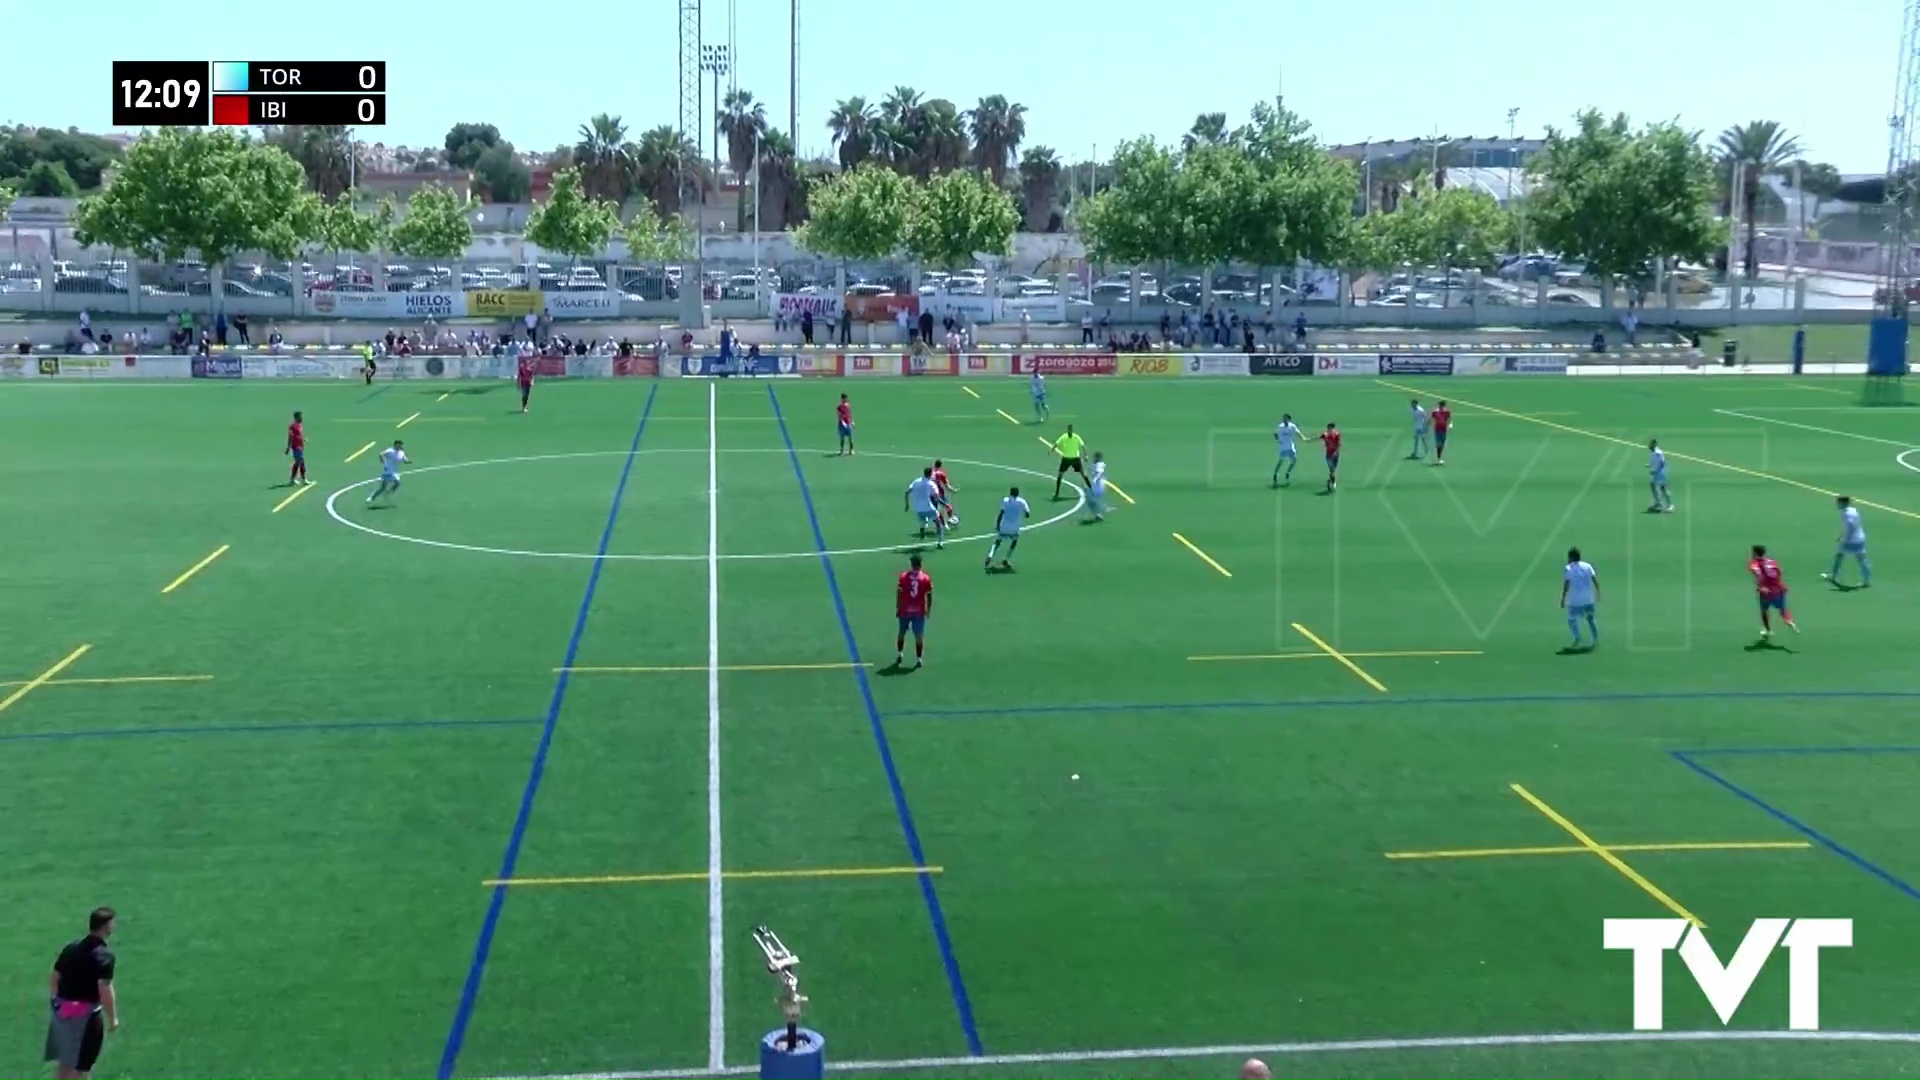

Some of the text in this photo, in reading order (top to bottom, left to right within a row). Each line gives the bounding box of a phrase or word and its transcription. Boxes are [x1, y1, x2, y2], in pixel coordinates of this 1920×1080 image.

[405, 295, 452, 306] HIELOS
[476, 293, 505, 305] RACC
[910, 580, 919, 598] 3
